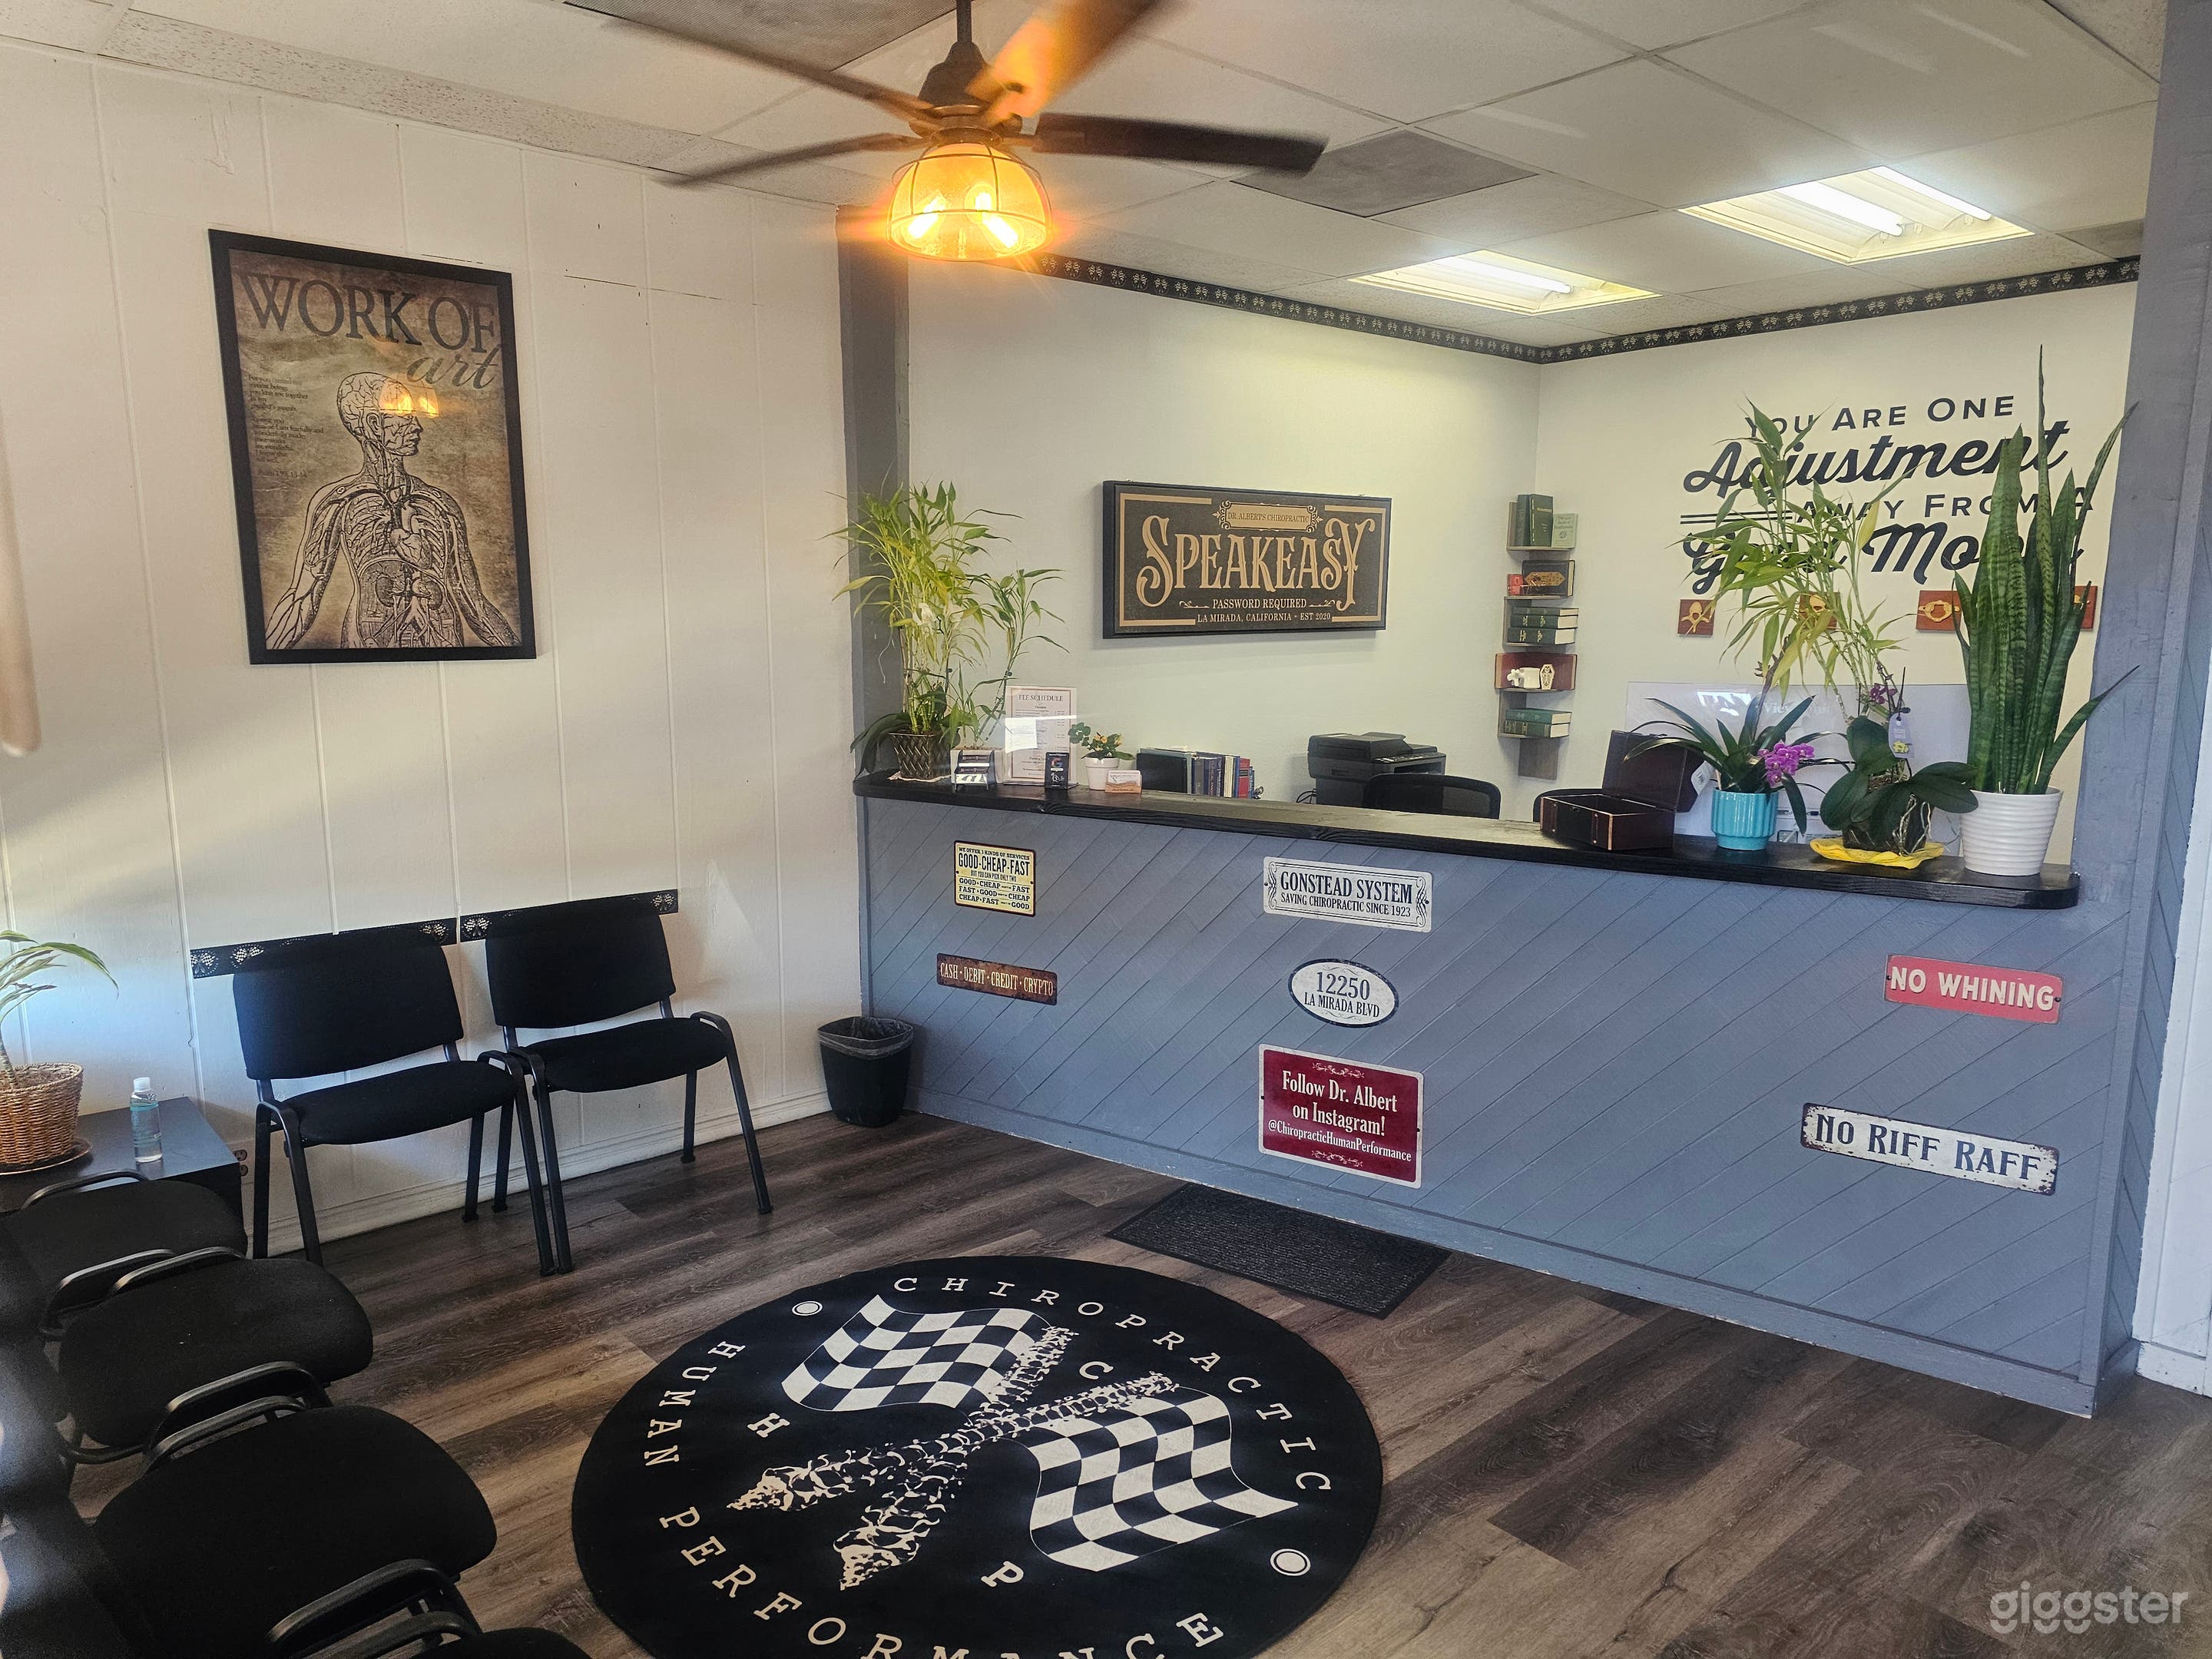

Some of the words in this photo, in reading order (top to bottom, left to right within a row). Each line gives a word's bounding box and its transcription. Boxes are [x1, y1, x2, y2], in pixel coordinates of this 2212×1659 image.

[240, 273, 422, 346] WORK
[428, 296, 498, 354] OF
[406, 344, 500, 390] art
[1745, 415, 1814, 437] YOU
[1831, 406, 1906, 431] ARE
[1927, 396, 2014, 422] ONE
[1267, 514, 1310, 522] CHIROPRACTIC
[1136, 515, 1375, 611] SPEAKEASY
[1863, 522, 2084, 584] Mo
[1197, 615, 1208, 624] LA
[1246, 613, 1292, 622] CALIFORNIA
[1300, 612, 1313, 621] EST
[1315, 612, 1331, 621] 2020
[1212, 598, 1260, 610] PASSWORD
[1262, 598, 1307, 609] REQUIRED
[959, 853, 978, 869] GOOD
[982, 856, 1007, 873] CHEAP
[1010, 859, 1030, 876] FAST
[1280, 871, 1352, 898] GONSTEAD
[1356, 879, 1412, 904] SYSTEM
[1281, 892, 1307, 906] SAVING
[1309, 896, 1365, 912] CHIROPRACTIC
[1366, 902, 1389, 915] SINCE
[1391, 906, 1411, 917] 1923
[940, 962, 959, 980] CASH
[964, 966, 986, 985] DEBIT
[991, 971, 1018, 990] CREDIT
[1023, 976, 1053, 996] CRYPTO
[1316, 972, 1370, 1000] 12250
[1890, 966, 1926, 993] NO
[1938, 972, 2054, 1012] WHINING
[1304, 992, 1315, 1006] LA
[1318, 995, 1353, 1014] MIRADA
[1356, 1002, 1379, 1018] BLVD
[1282, 1070, 1325, 1098] Follow
[1329, 1079, 1349, 1102] Dr.
[1353, 1084, 1397, 1112] Albert
[1293, 1104, 1308, 1120] on
[1313, 1101, 1386, 1137] Instagram!
[1268, 1119, 1412, 1162] @ChiropracticHumanPerformance
[1814, 1114, 1854, 1145] NO
[1867, 1124, 1941, 1161] RIFF
[1953, 1140, 2041, 1180] RAFF
[644, 1340, 746, 1468] HUMAN
[893, 1277, 1331, 1493] CHIROPRACTIC
[659, 1506, 1224, 1659] PERFORCE
